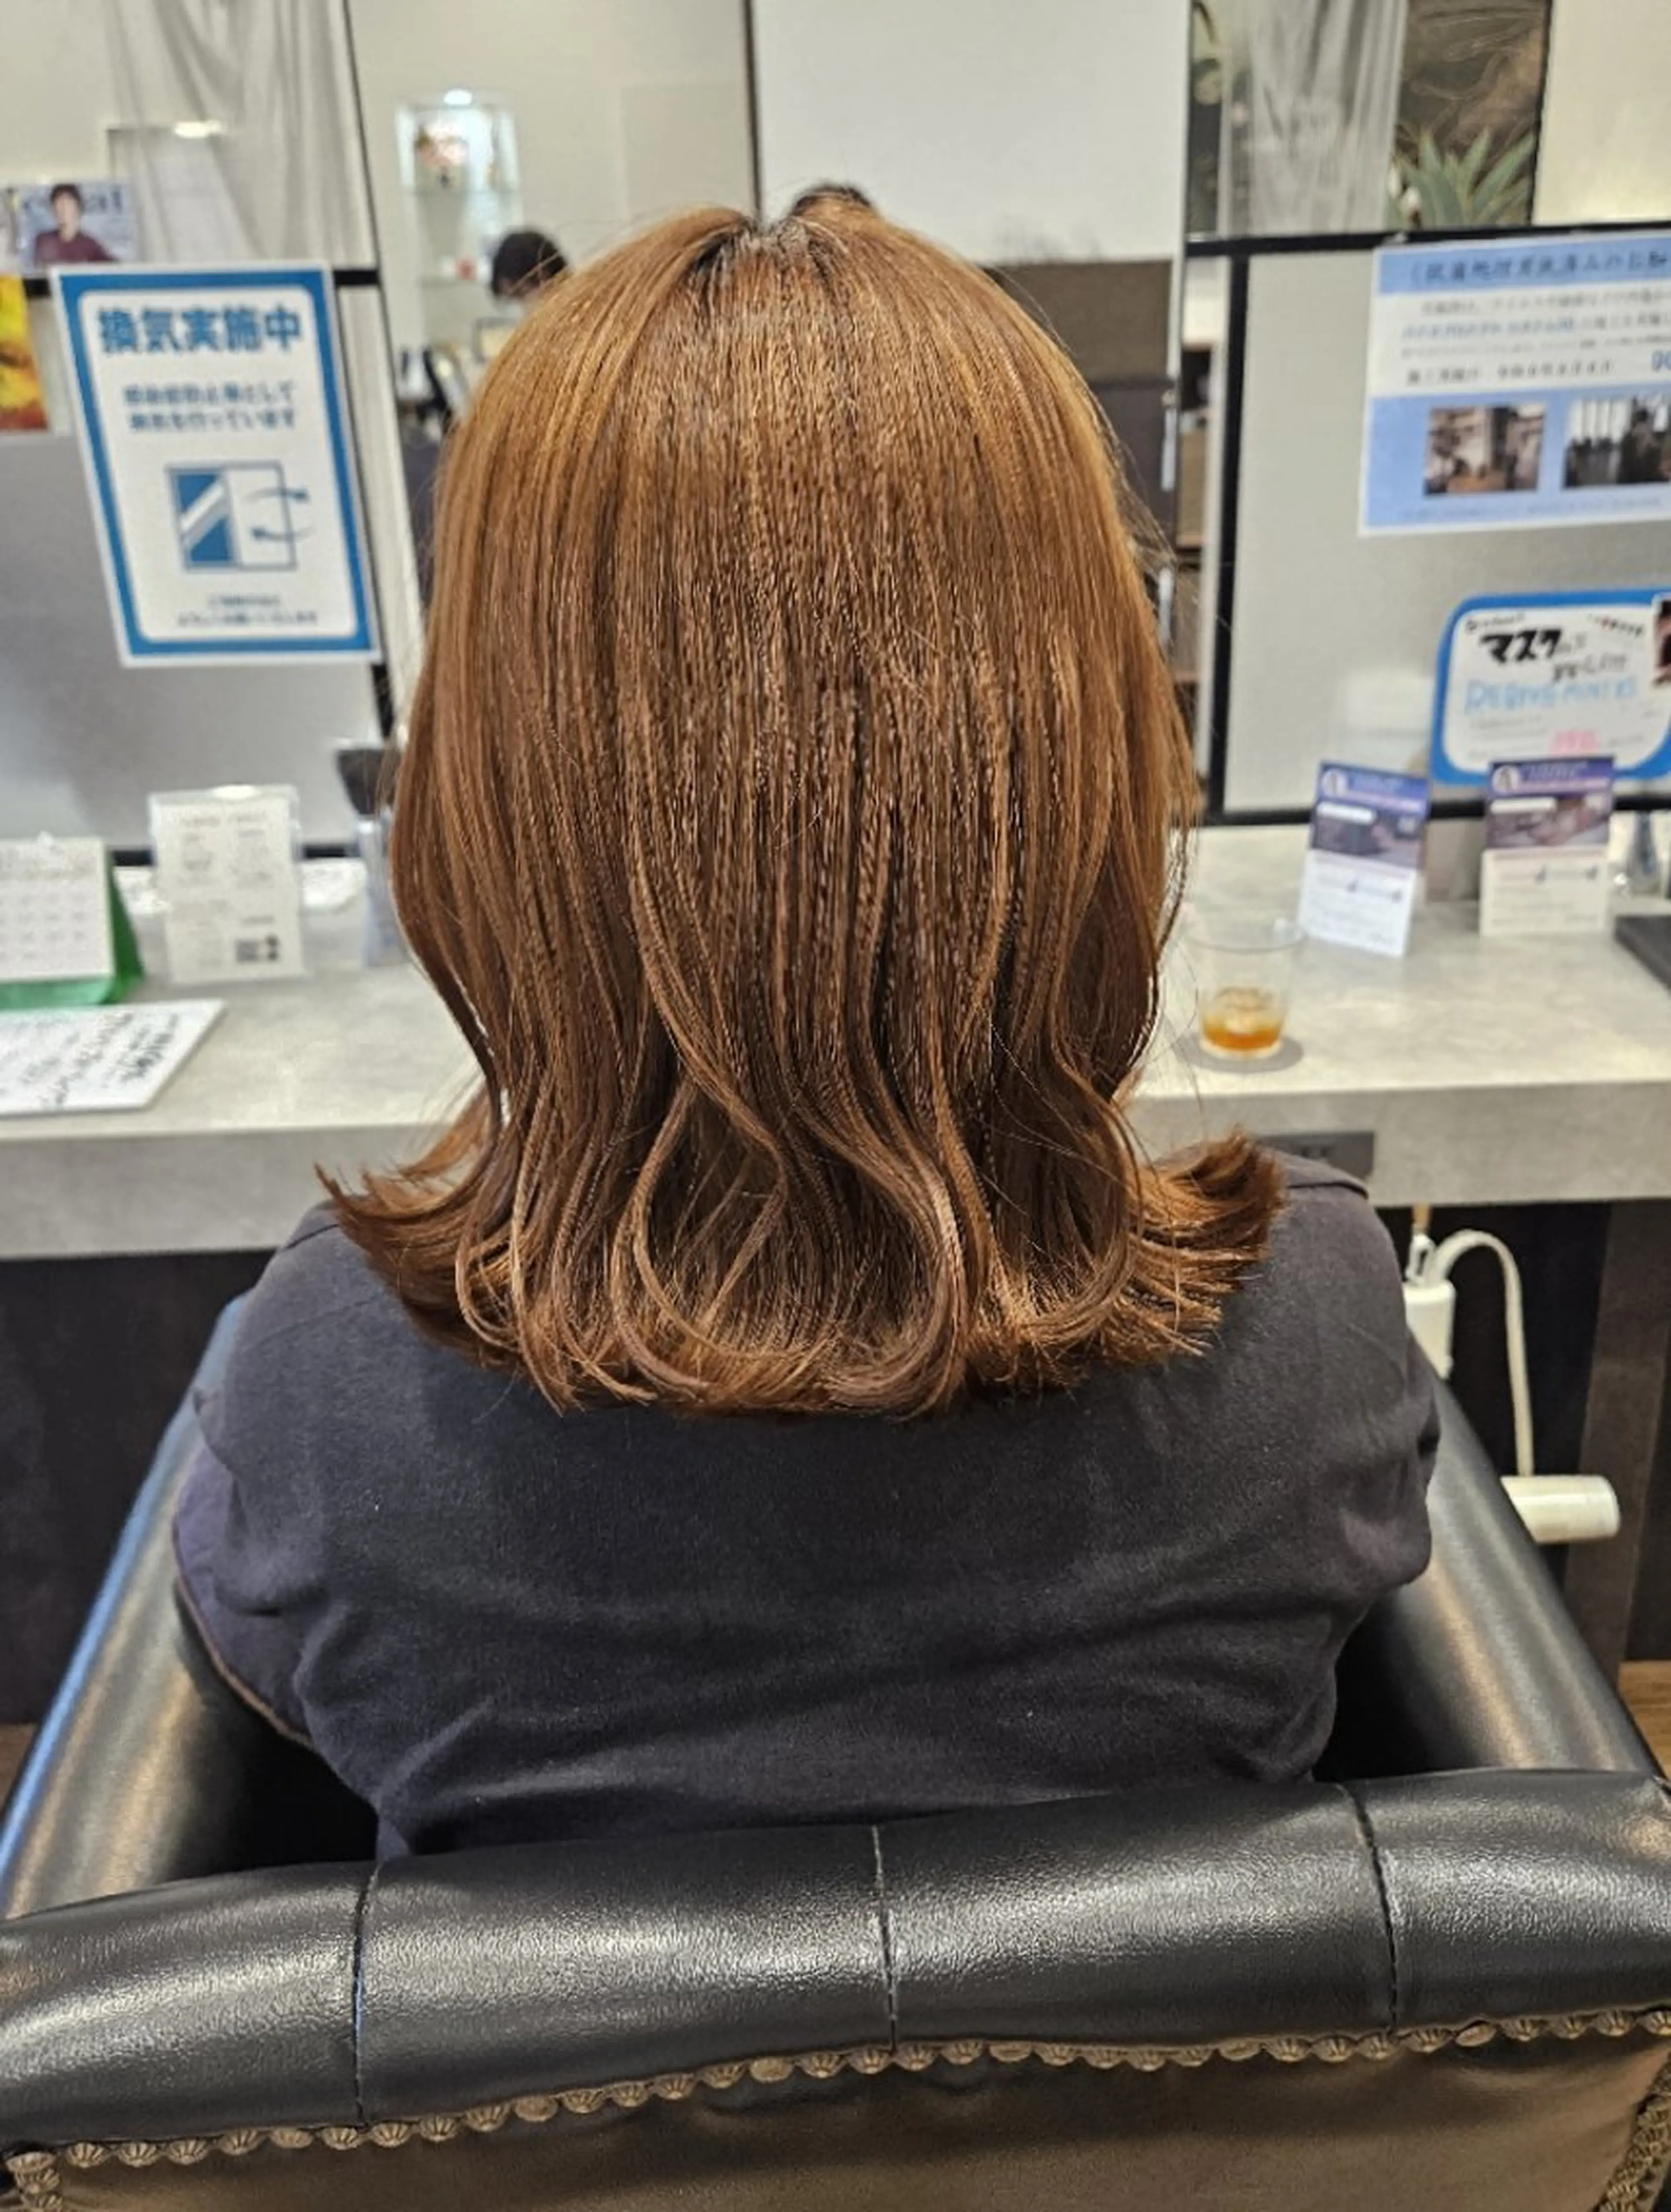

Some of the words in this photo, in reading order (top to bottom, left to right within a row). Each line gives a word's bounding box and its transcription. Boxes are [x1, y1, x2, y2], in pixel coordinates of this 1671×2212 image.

[98, 303, 301, 354] 換気実施中
[1480, 627, 1562, 664] マスク
